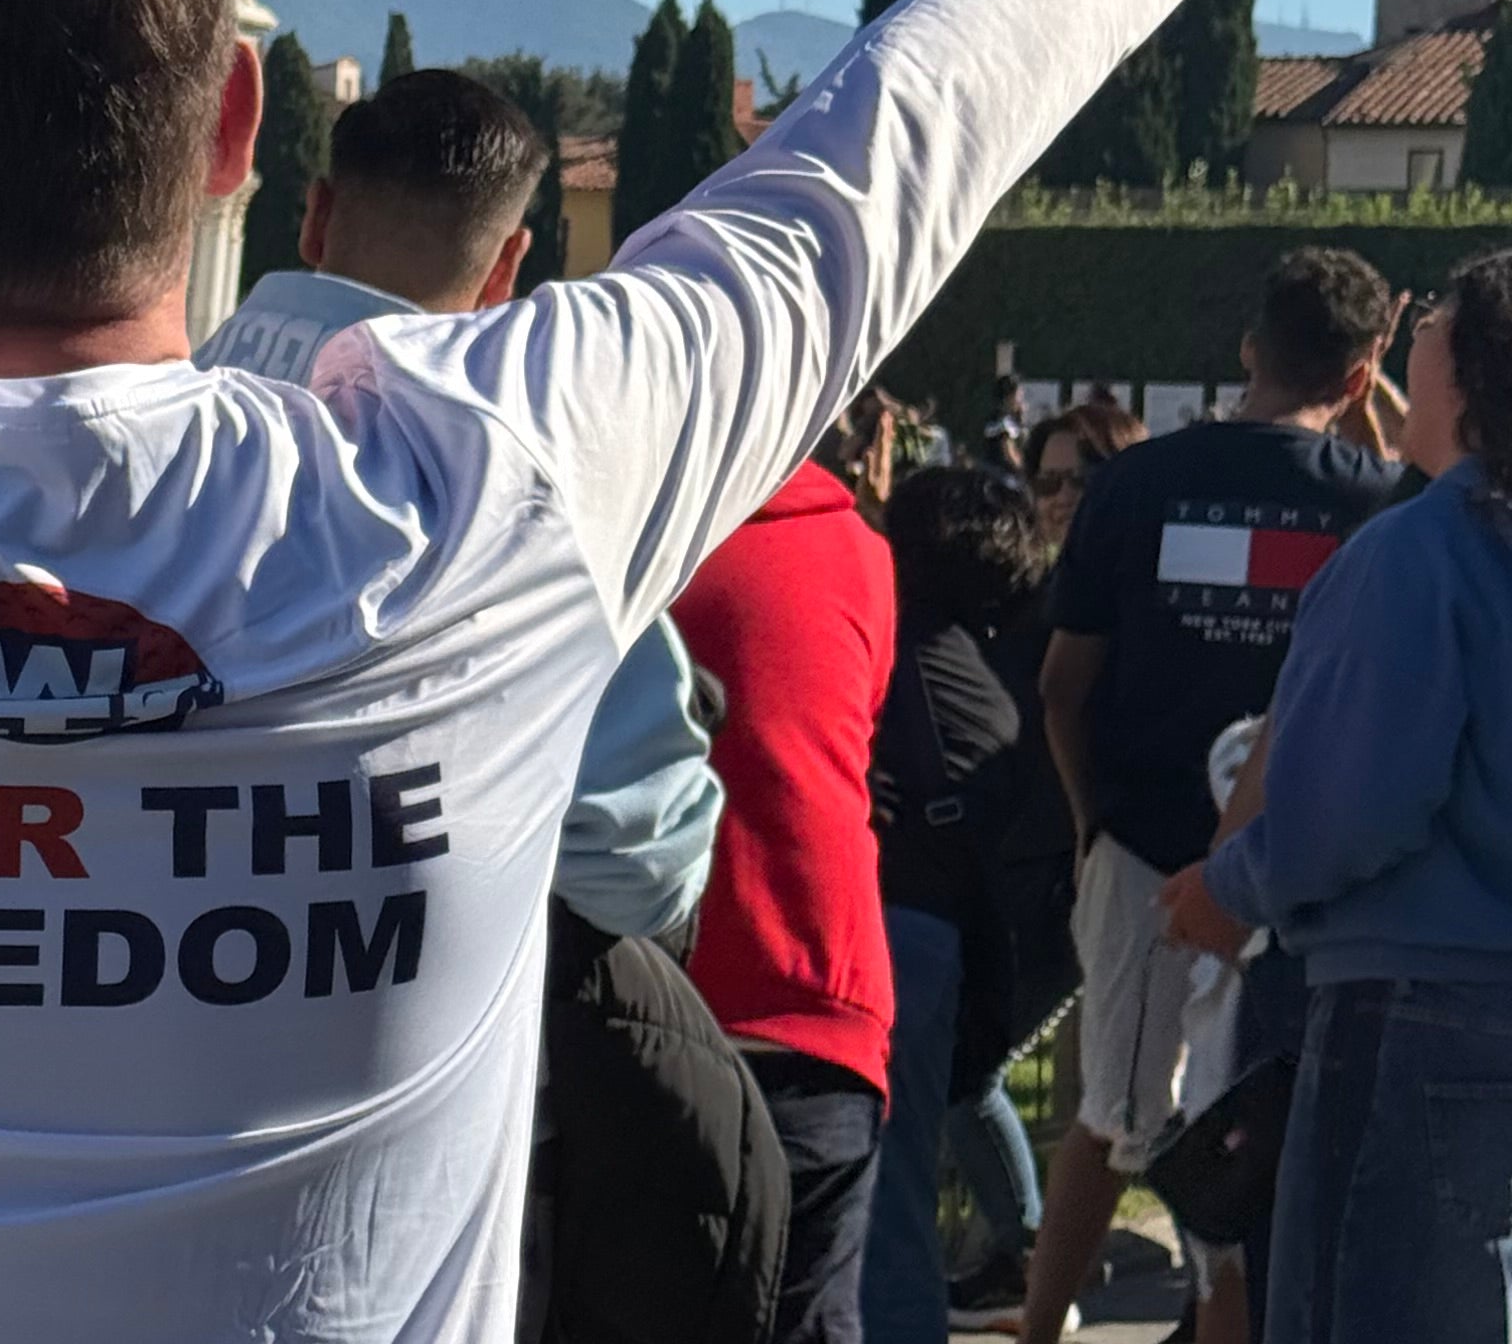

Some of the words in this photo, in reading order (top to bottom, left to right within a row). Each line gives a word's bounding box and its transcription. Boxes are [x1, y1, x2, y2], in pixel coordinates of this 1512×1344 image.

[1177, 504, 1331, 527] TOMMY
[1169, 588, 1288, 610] JEAN
[1265, 618, 1290, 635] CIT
[140, 762, 450, 878] THE
